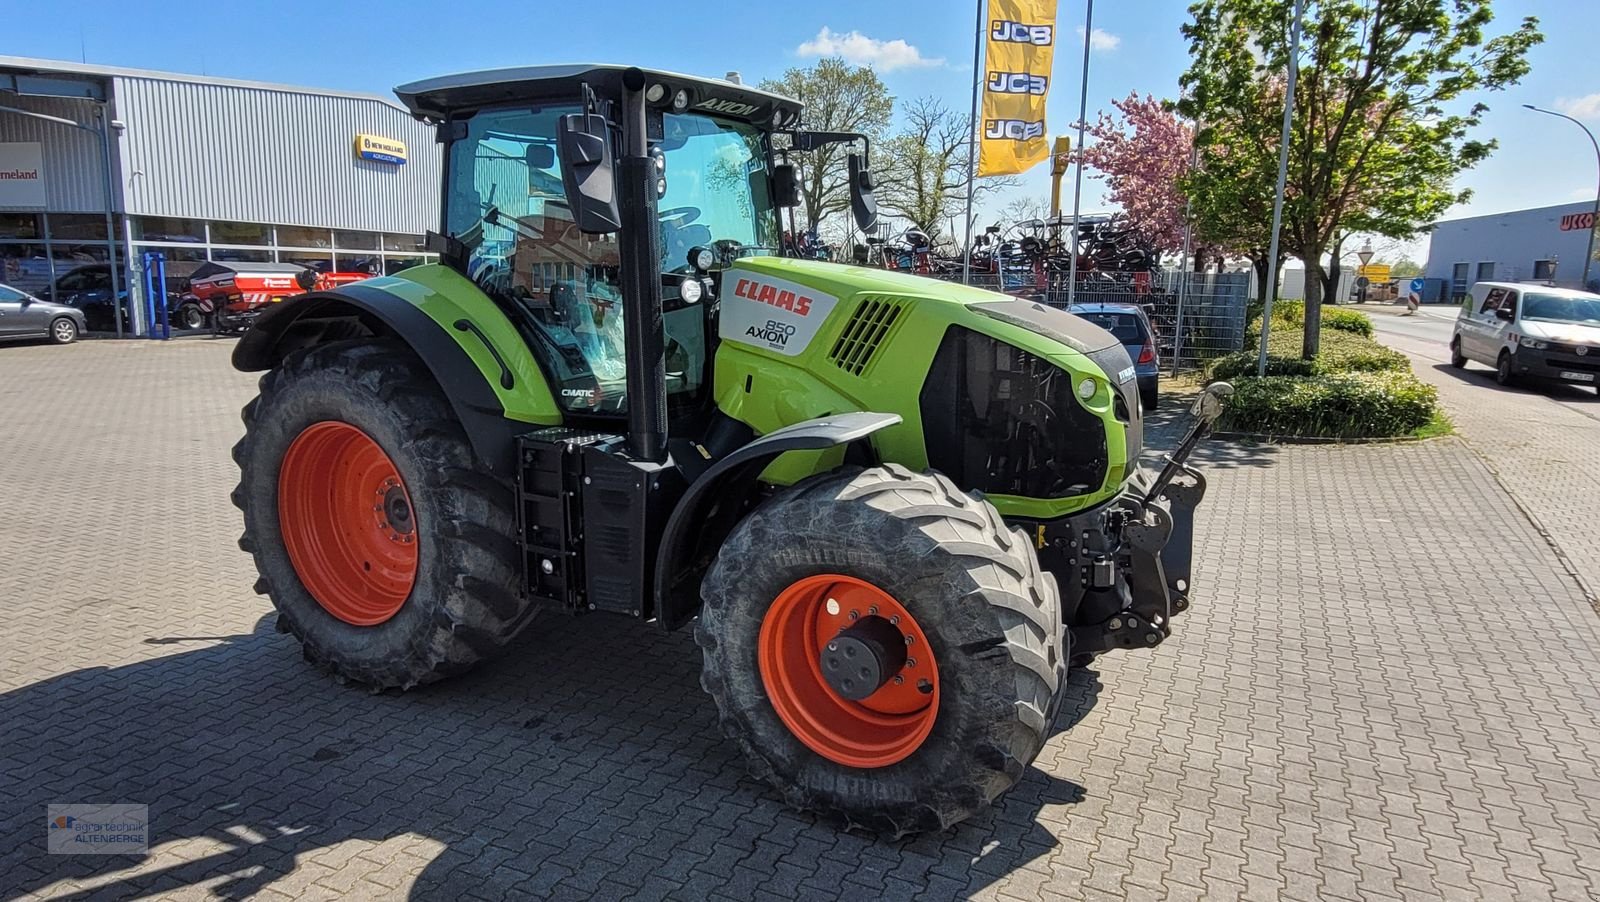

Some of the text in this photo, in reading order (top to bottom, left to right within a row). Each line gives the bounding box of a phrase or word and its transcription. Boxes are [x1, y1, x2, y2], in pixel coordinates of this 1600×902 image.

[991, 20, 1052, 45] JCB
[988, 72, 1047, 94] JCB
[695, 97, 760, 116] AXION
[986, 119, 1043, 140] JCB
[371, 142, 404, 153] NEW HOLLAND
[735, 278, 813, 317] CLAAS
[745, 326, 789, 346] AXION
[765, 319, 797, 336] 850
[561, 388, 595, 397] CMATIC
